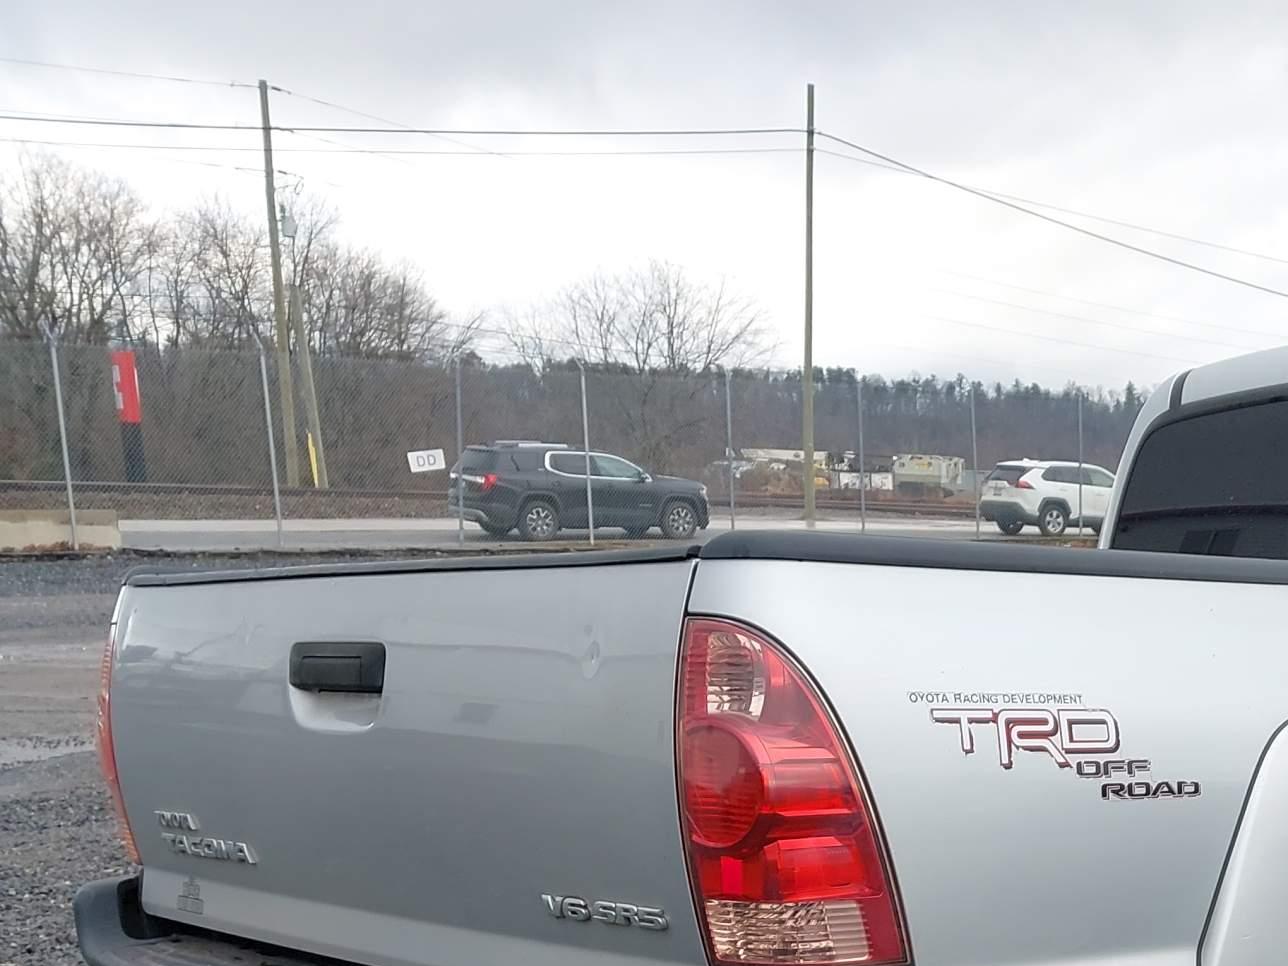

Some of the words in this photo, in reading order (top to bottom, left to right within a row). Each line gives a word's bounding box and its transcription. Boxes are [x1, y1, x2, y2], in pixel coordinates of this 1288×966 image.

[416, 453, 437, 468] DD
[906, 691, 950, 704] OYOTA
[953, 692, 999, 704] RACING
[1002, 693, 1083, 705] DEVELOPMENT
[930, 708, 1121, 769] TRD
[1075, 758, 1152, 778] OFF
[1100, 780, 1202, 800] ROAD
[160, 832, 258, 864] TACOMA
[541, 893, 591, 921] V6
[592, 900, 669, 931] SR5
